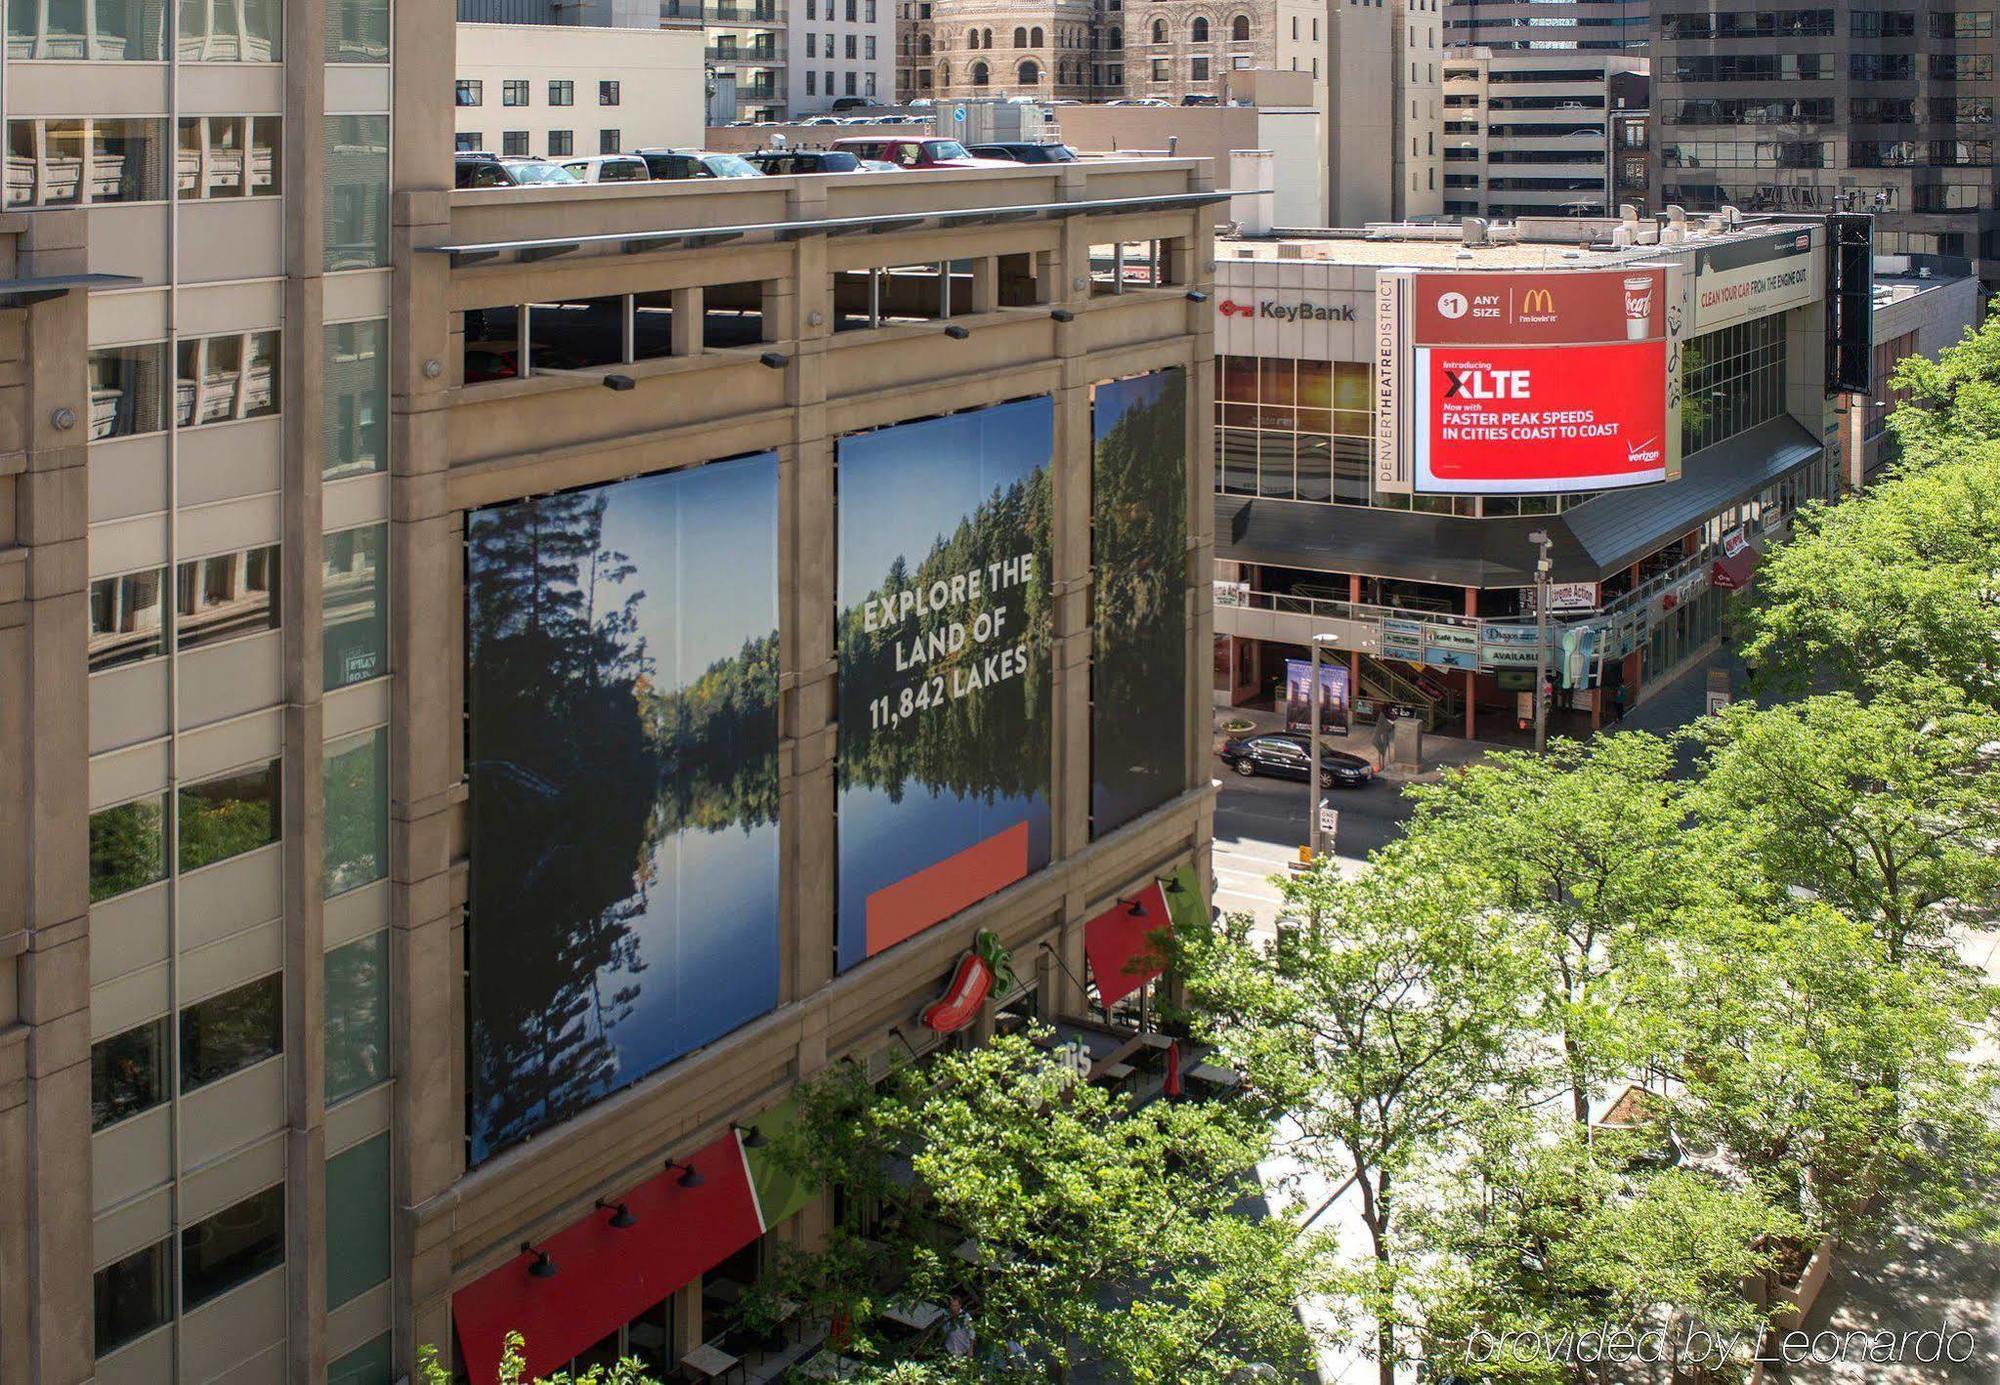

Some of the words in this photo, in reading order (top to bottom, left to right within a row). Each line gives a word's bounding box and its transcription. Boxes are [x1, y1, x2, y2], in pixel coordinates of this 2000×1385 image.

[1701, 289, 1721, 308] CLEAN
[1721, 284, 1738, 302] YOUR
[1737, 282, 1750, 299] CAR
[1750, 278, 1766, 295] FROM
[1766, 276, 1777, 291] THE
[1777, 271, 1796, 289] ENGINE
[1795, 268, 1807, 284] OUT
[1442, 298, 1459, 314] $1
[1473, 295, 1500, 306] ANY
[1260, 301, 1356, 323] KeyBank
[1472, 307, 1501, 318] SIZE
[1443, 360, 1492, 371] Introducing
[1444, 370, 1531, 399] XLTE
[1443, 403, 1462, 412] Now
[1463, 403, 1482, 412] with
[1442, 412, 1499, 425] FASTER
[1501, 411, 1540, 425] PEAK
[1542, 410, 1594, 423] SPEEDS
[1442, 428, 1458, 440] IN
[1460, 428, 1507, 440] CITIES
[1510, 427, 1557, 440] COAST
[1559, 426, 1578, 438] TO
[1579, 422, 1620, 437] COAST
[1628, 450, 1660, 462] verizon
[864, 569, 982, 634] EXPLORE
[988, 552, 1034, 593] THE
[895, 620, 966, 673] LAND
[972, 606, 1008, 644] OF
[868, 675, 945, 731] 11,842
[951, 645, 1029, 701] LAKES
